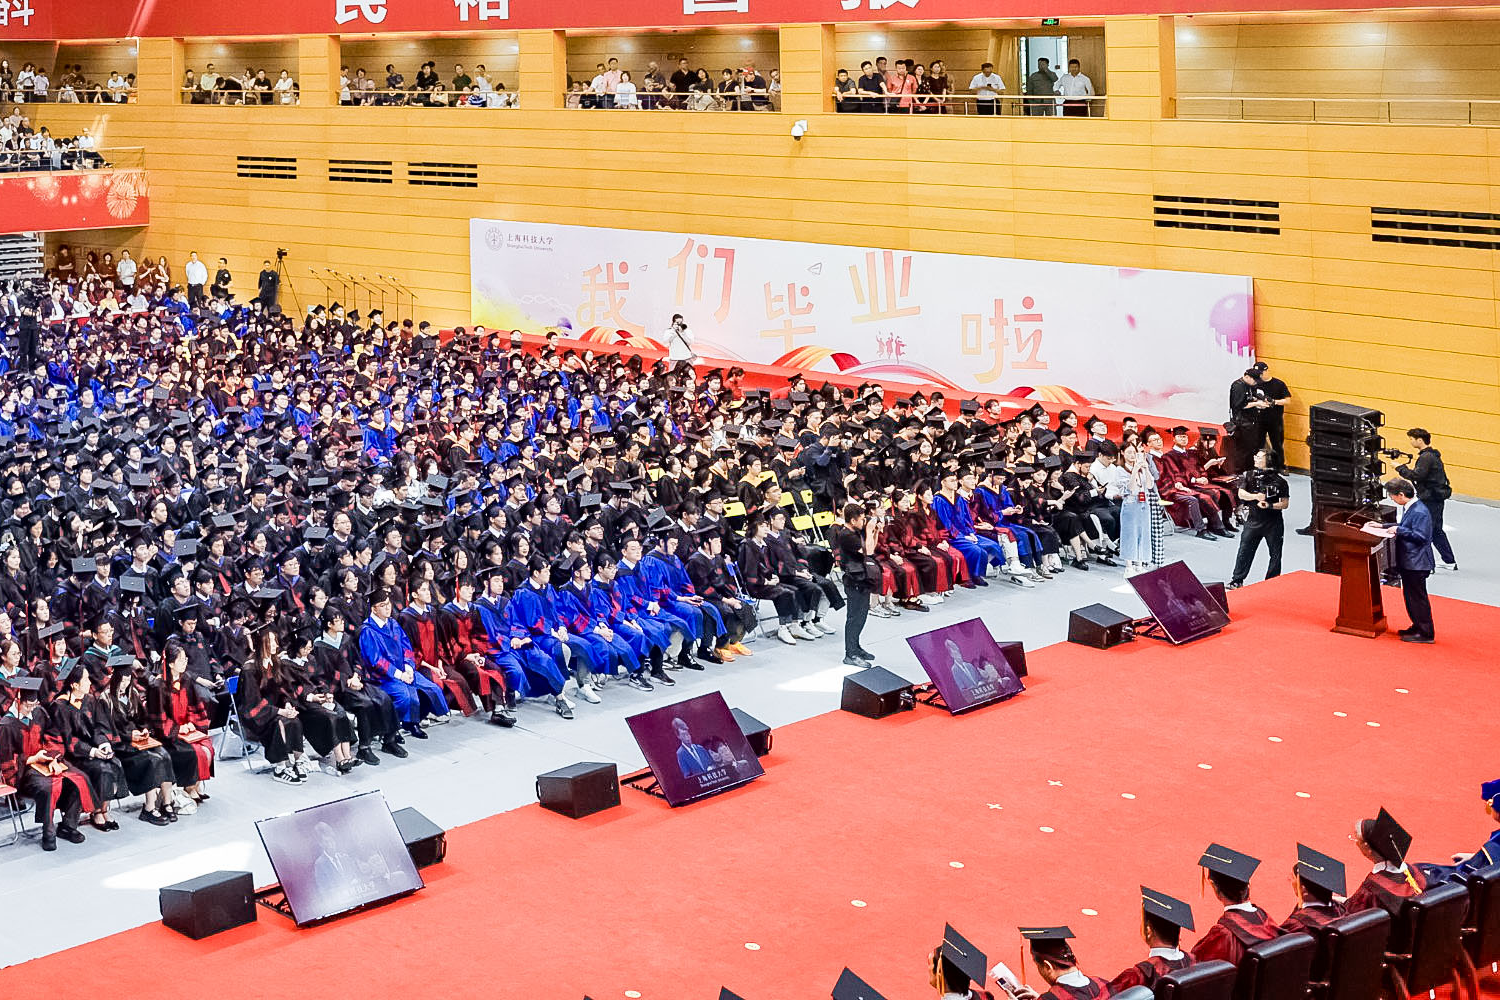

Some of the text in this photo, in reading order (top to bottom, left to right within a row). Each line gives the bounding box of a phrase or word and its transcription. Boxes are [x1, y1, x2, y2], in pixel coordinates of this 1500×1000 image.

[576, 237, 1048, 384] 我们毕业啦
